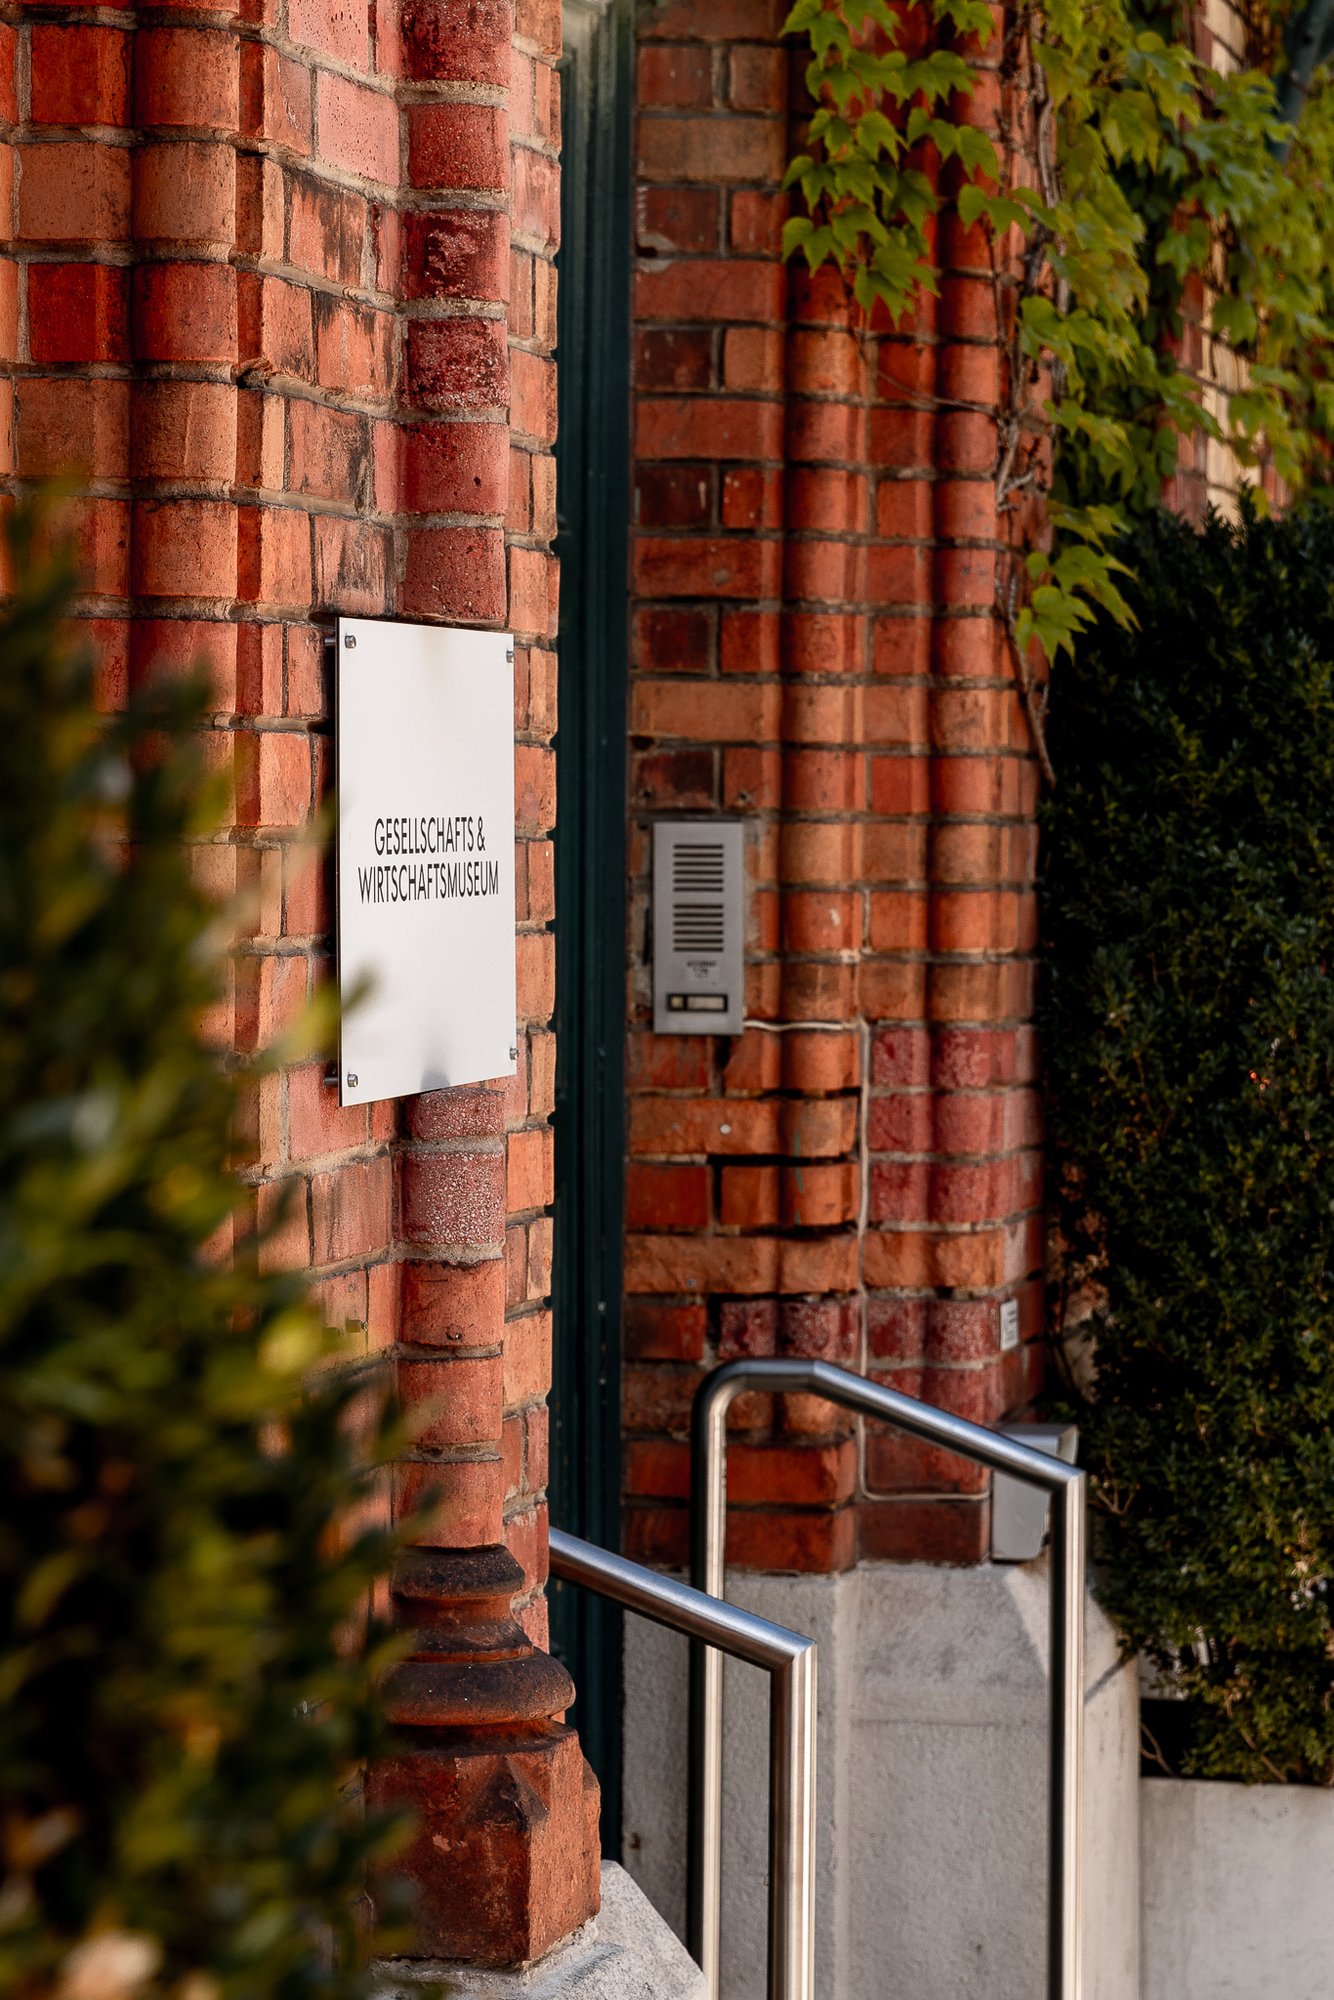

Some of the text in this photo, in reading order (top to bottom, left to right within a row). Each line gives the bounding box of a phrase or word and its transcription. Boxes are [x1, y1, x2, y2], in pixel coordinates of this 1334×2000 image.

[374, 816, 486, 856] GESELLSCHAFTS &
[357, 860, 499, 904] WIRTSCHAFTSMUSEUM
